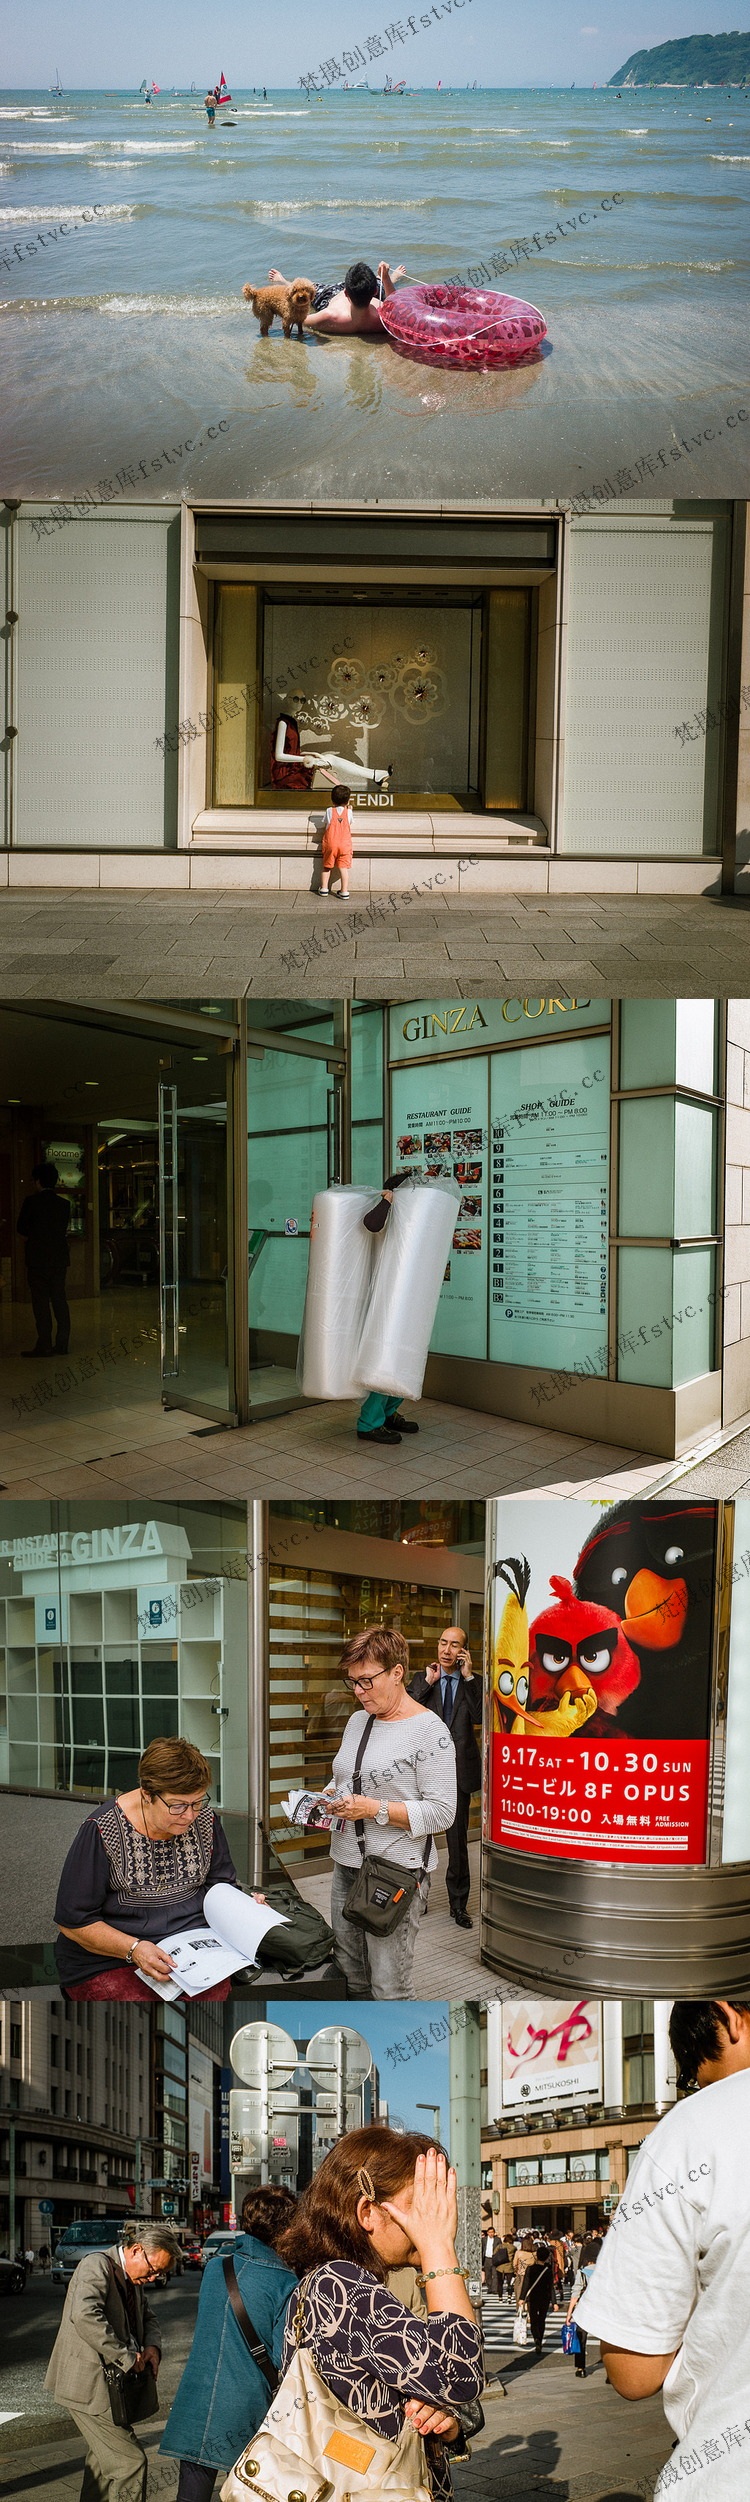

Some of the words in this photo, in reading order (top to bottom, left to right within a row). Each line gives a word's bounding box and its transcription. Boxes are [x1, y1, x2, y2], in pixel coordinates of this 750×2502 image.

[349, 793, 394, 807] FENDI
[403, 1004, 488, 1042] GINZA
[549, 1098, 575, 1108] GUIDE
[407, 1109, 447, 1120] RESTAURANT
[450, 1107, 472, 1116] GUIDE
[494, 1129, 503, 1138] 10
[47, 1149, 80, 1158] Florame
[494, 1278, 503, 1287] B1
[13, 1531, 69, 1551] INSTANT
[71, 1522, 161, 1561] GINZA
[13, 1551, 53, 1567] GUIDE
[501, 1745, 537, 1766] 9.17
[539, 1757, 562, 1768] SAT
[579, 1751, 658, 1773] 10.30
[663, 1762, 691, 1773] SUN
[501, 1774, 577, 1797] ソニービル
[584, 1782, 613, 1800] 8F
[623, 1784, 690, 1801] OPUS
[501, 1798, 592, 1824] 11:00-19:00
[600, 1813, 651, 1827] 入場無料
[535, 2077, 579, 2092] MITSUKOSHI
